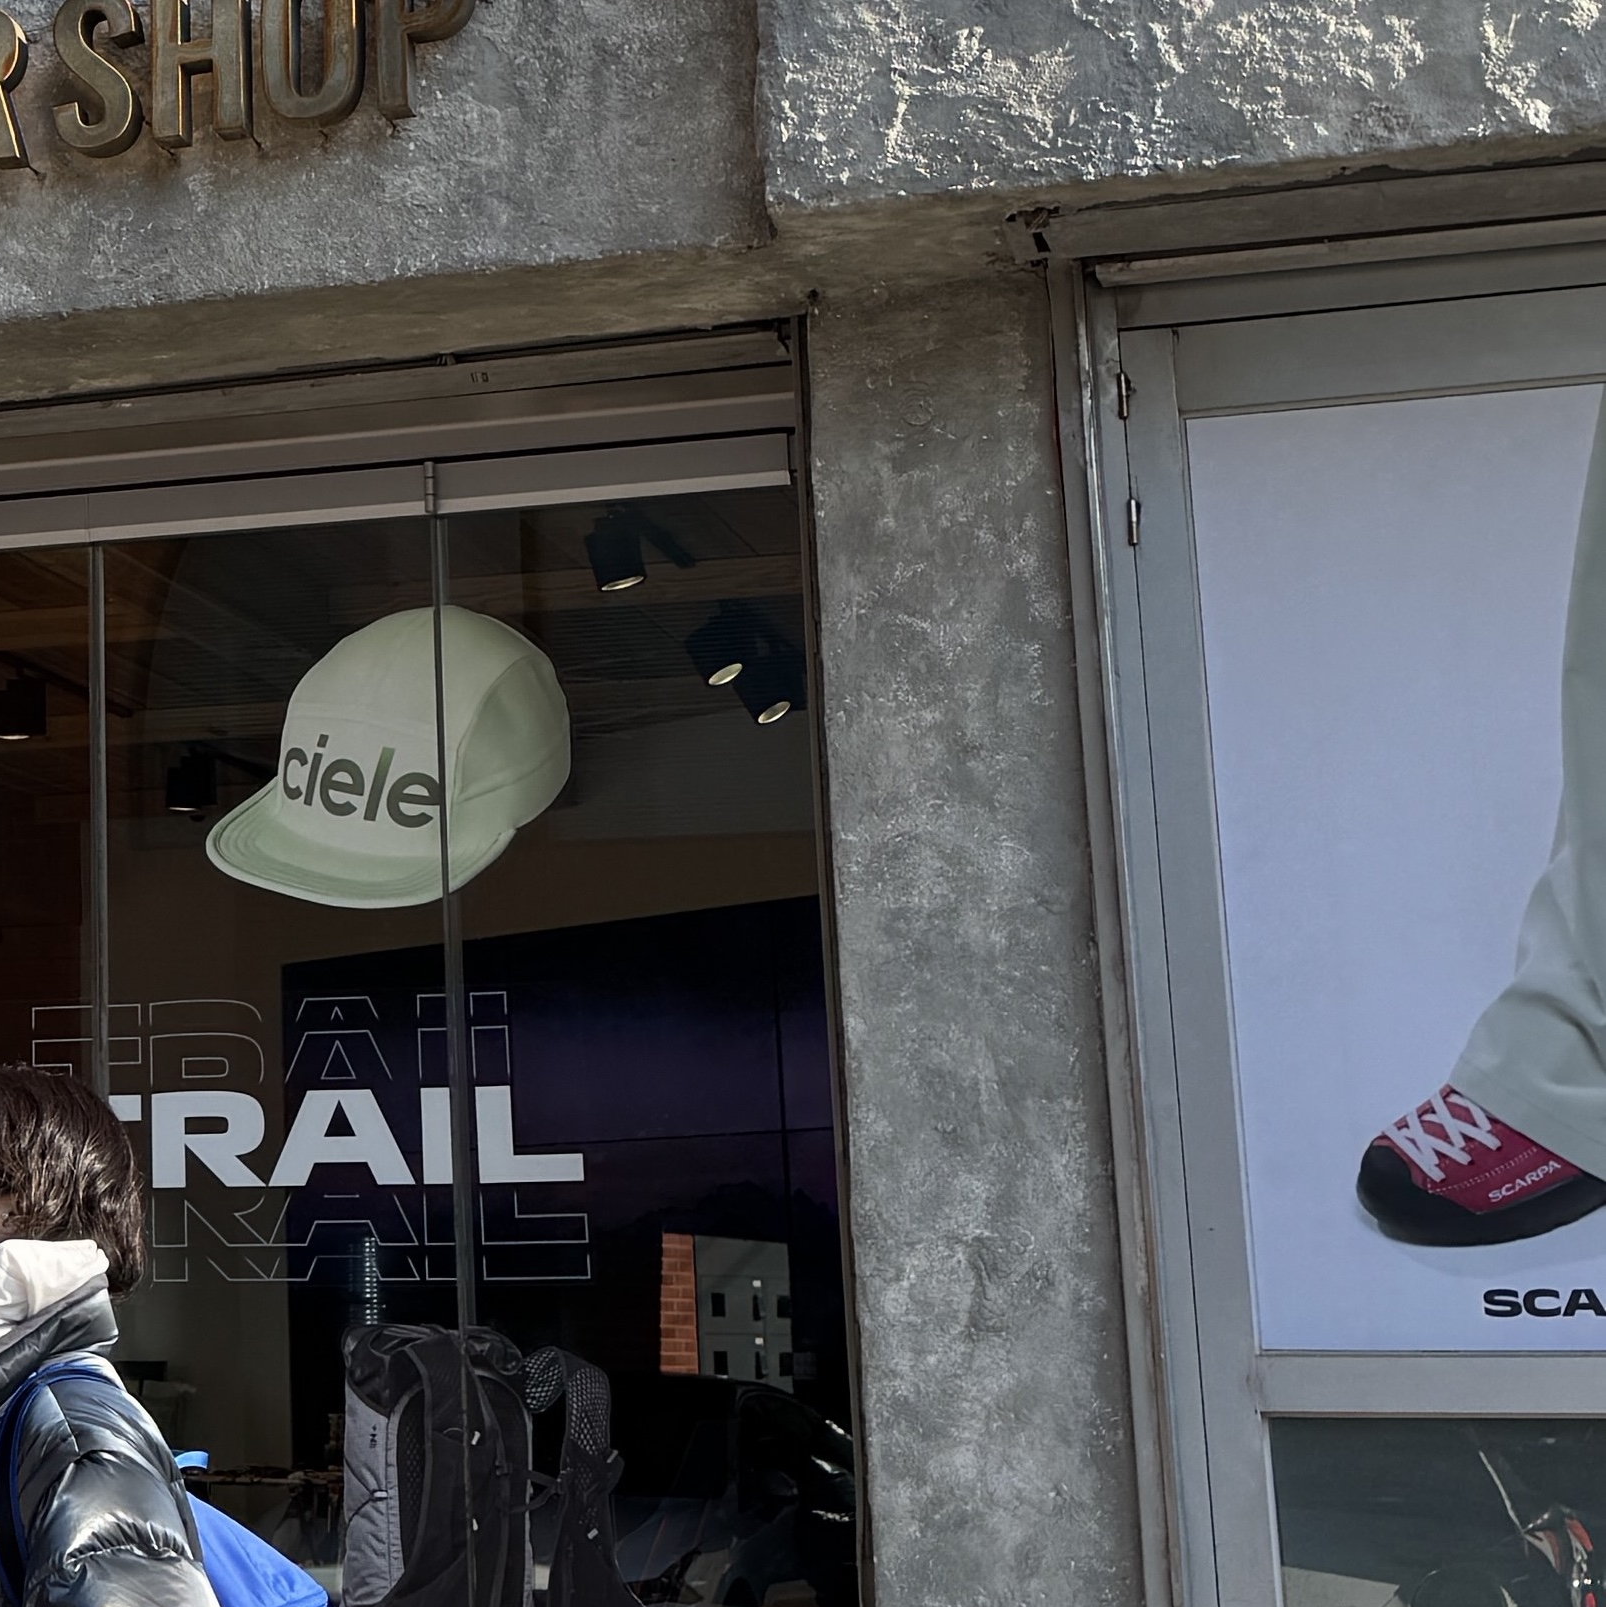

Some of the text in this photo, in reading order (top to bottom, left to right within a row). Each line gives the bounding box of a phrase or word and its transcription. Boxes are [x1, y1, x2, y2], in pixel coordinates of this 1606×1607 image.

[54, 0, 474, 158] SHOP
[281, 733, 442, 828] ciele
[108, 1085, 585, 1189] RAIL
[1487, 1159, 1562, 1203] SCARPA
[1482, 1288, 1606, 1318] SCA
